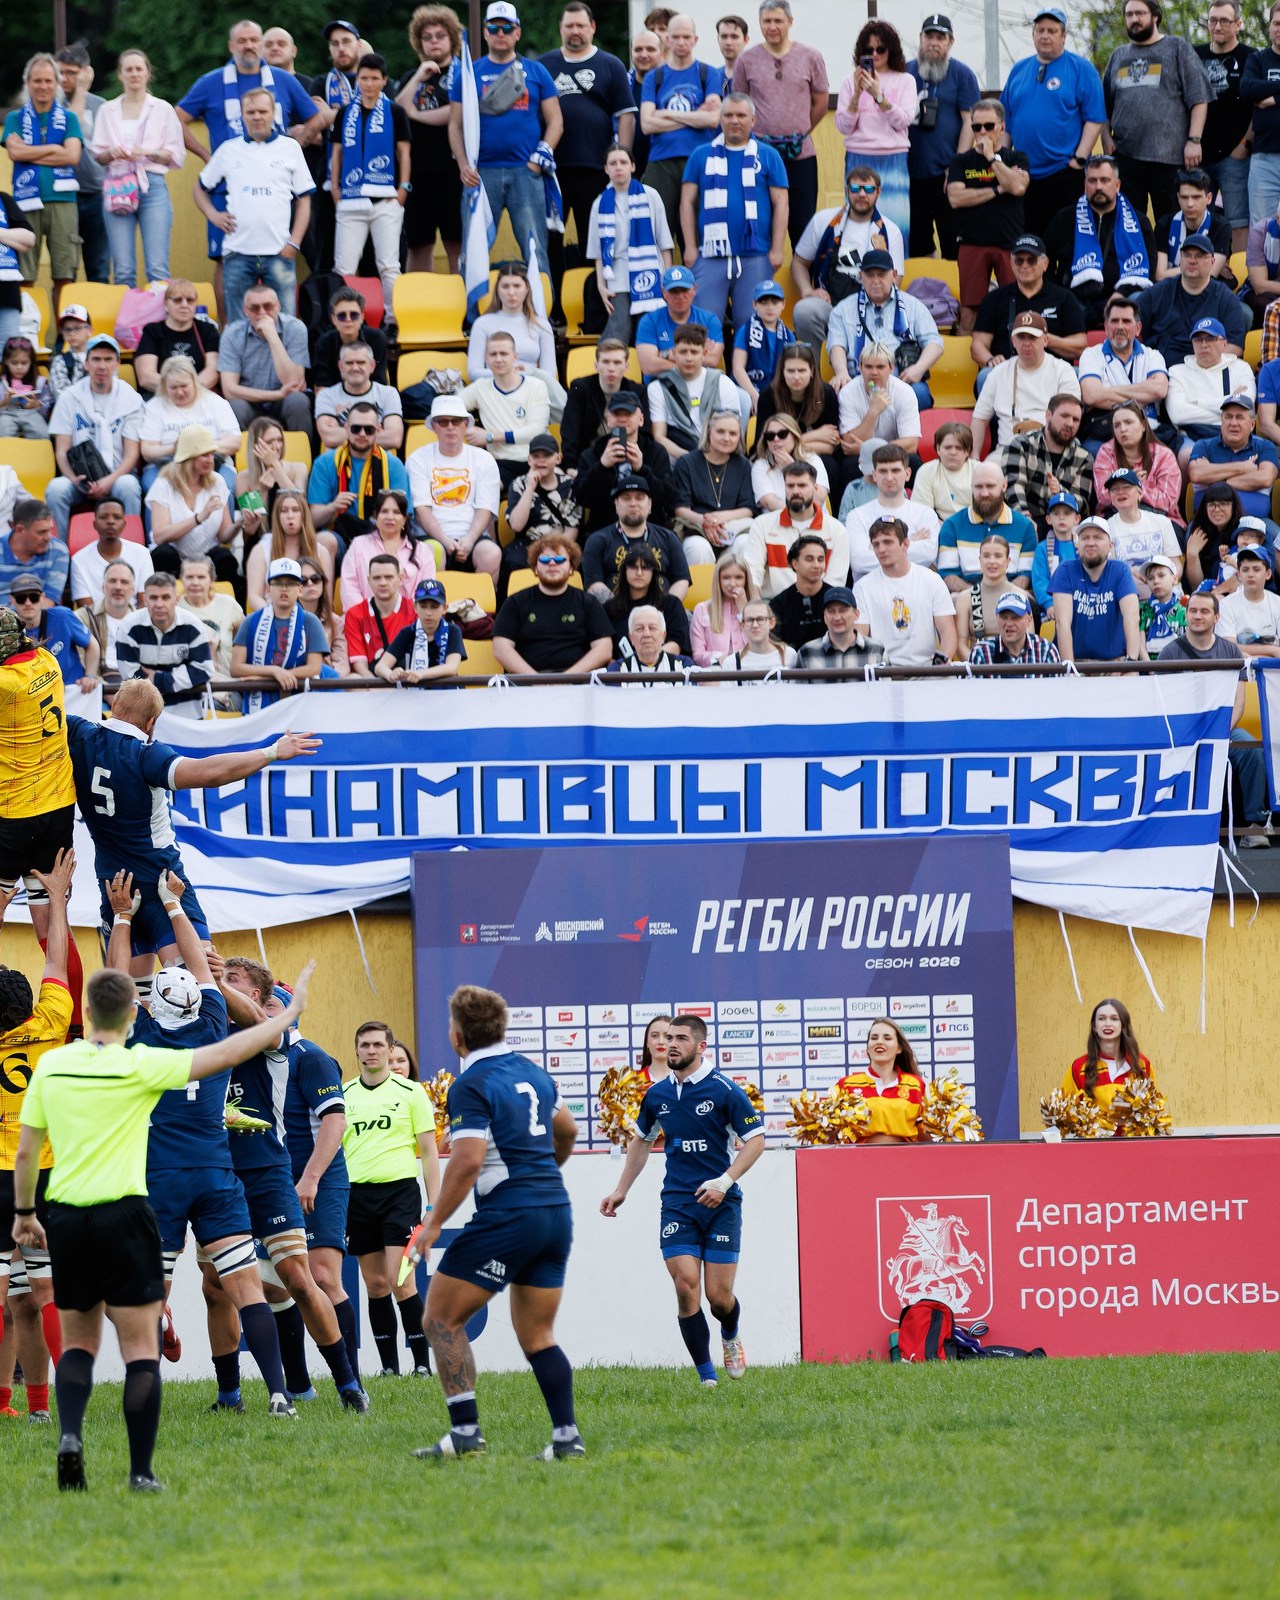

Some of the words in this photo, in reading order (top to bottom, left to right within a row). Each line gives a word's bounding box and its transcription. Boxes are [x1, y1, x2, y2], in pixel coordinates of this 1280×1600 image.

[251, 186, 272, 197] ВТБ
[40, 694, 62, 738] 5
[91, 766, 116, 817] 5
[805, 744, 1214, 832] МОСКВЫ
[480, 923, 515, 931] Департамент
[555, 918, 604, 932] МОСКОВСКИЙ
[691, 897, 814, 954] РЕГБИ
[817, 892, 971, 950] РОССИИ
[555, 931, 578, 942] СПОРТ
[865, 958, 913, 969] СЕЗОН
[919, 956, 960, 967] 2026
[725, 1031, 752, 1039] LANCET
[228, 1083, 244, 1097] ТБ
[561, 1081, 584, 1089] legalbet
[515, 1082, 546, 1136] 2
[682, 1140, 708, 1152] ВТБ
[273, 1215, 287, 1225] ВТБ
[1016, 1198, 1249, 1233] Департамент
[1019, 1243, 1136, 1275] спорта
[1021, 1284, 1139, 1317] города
